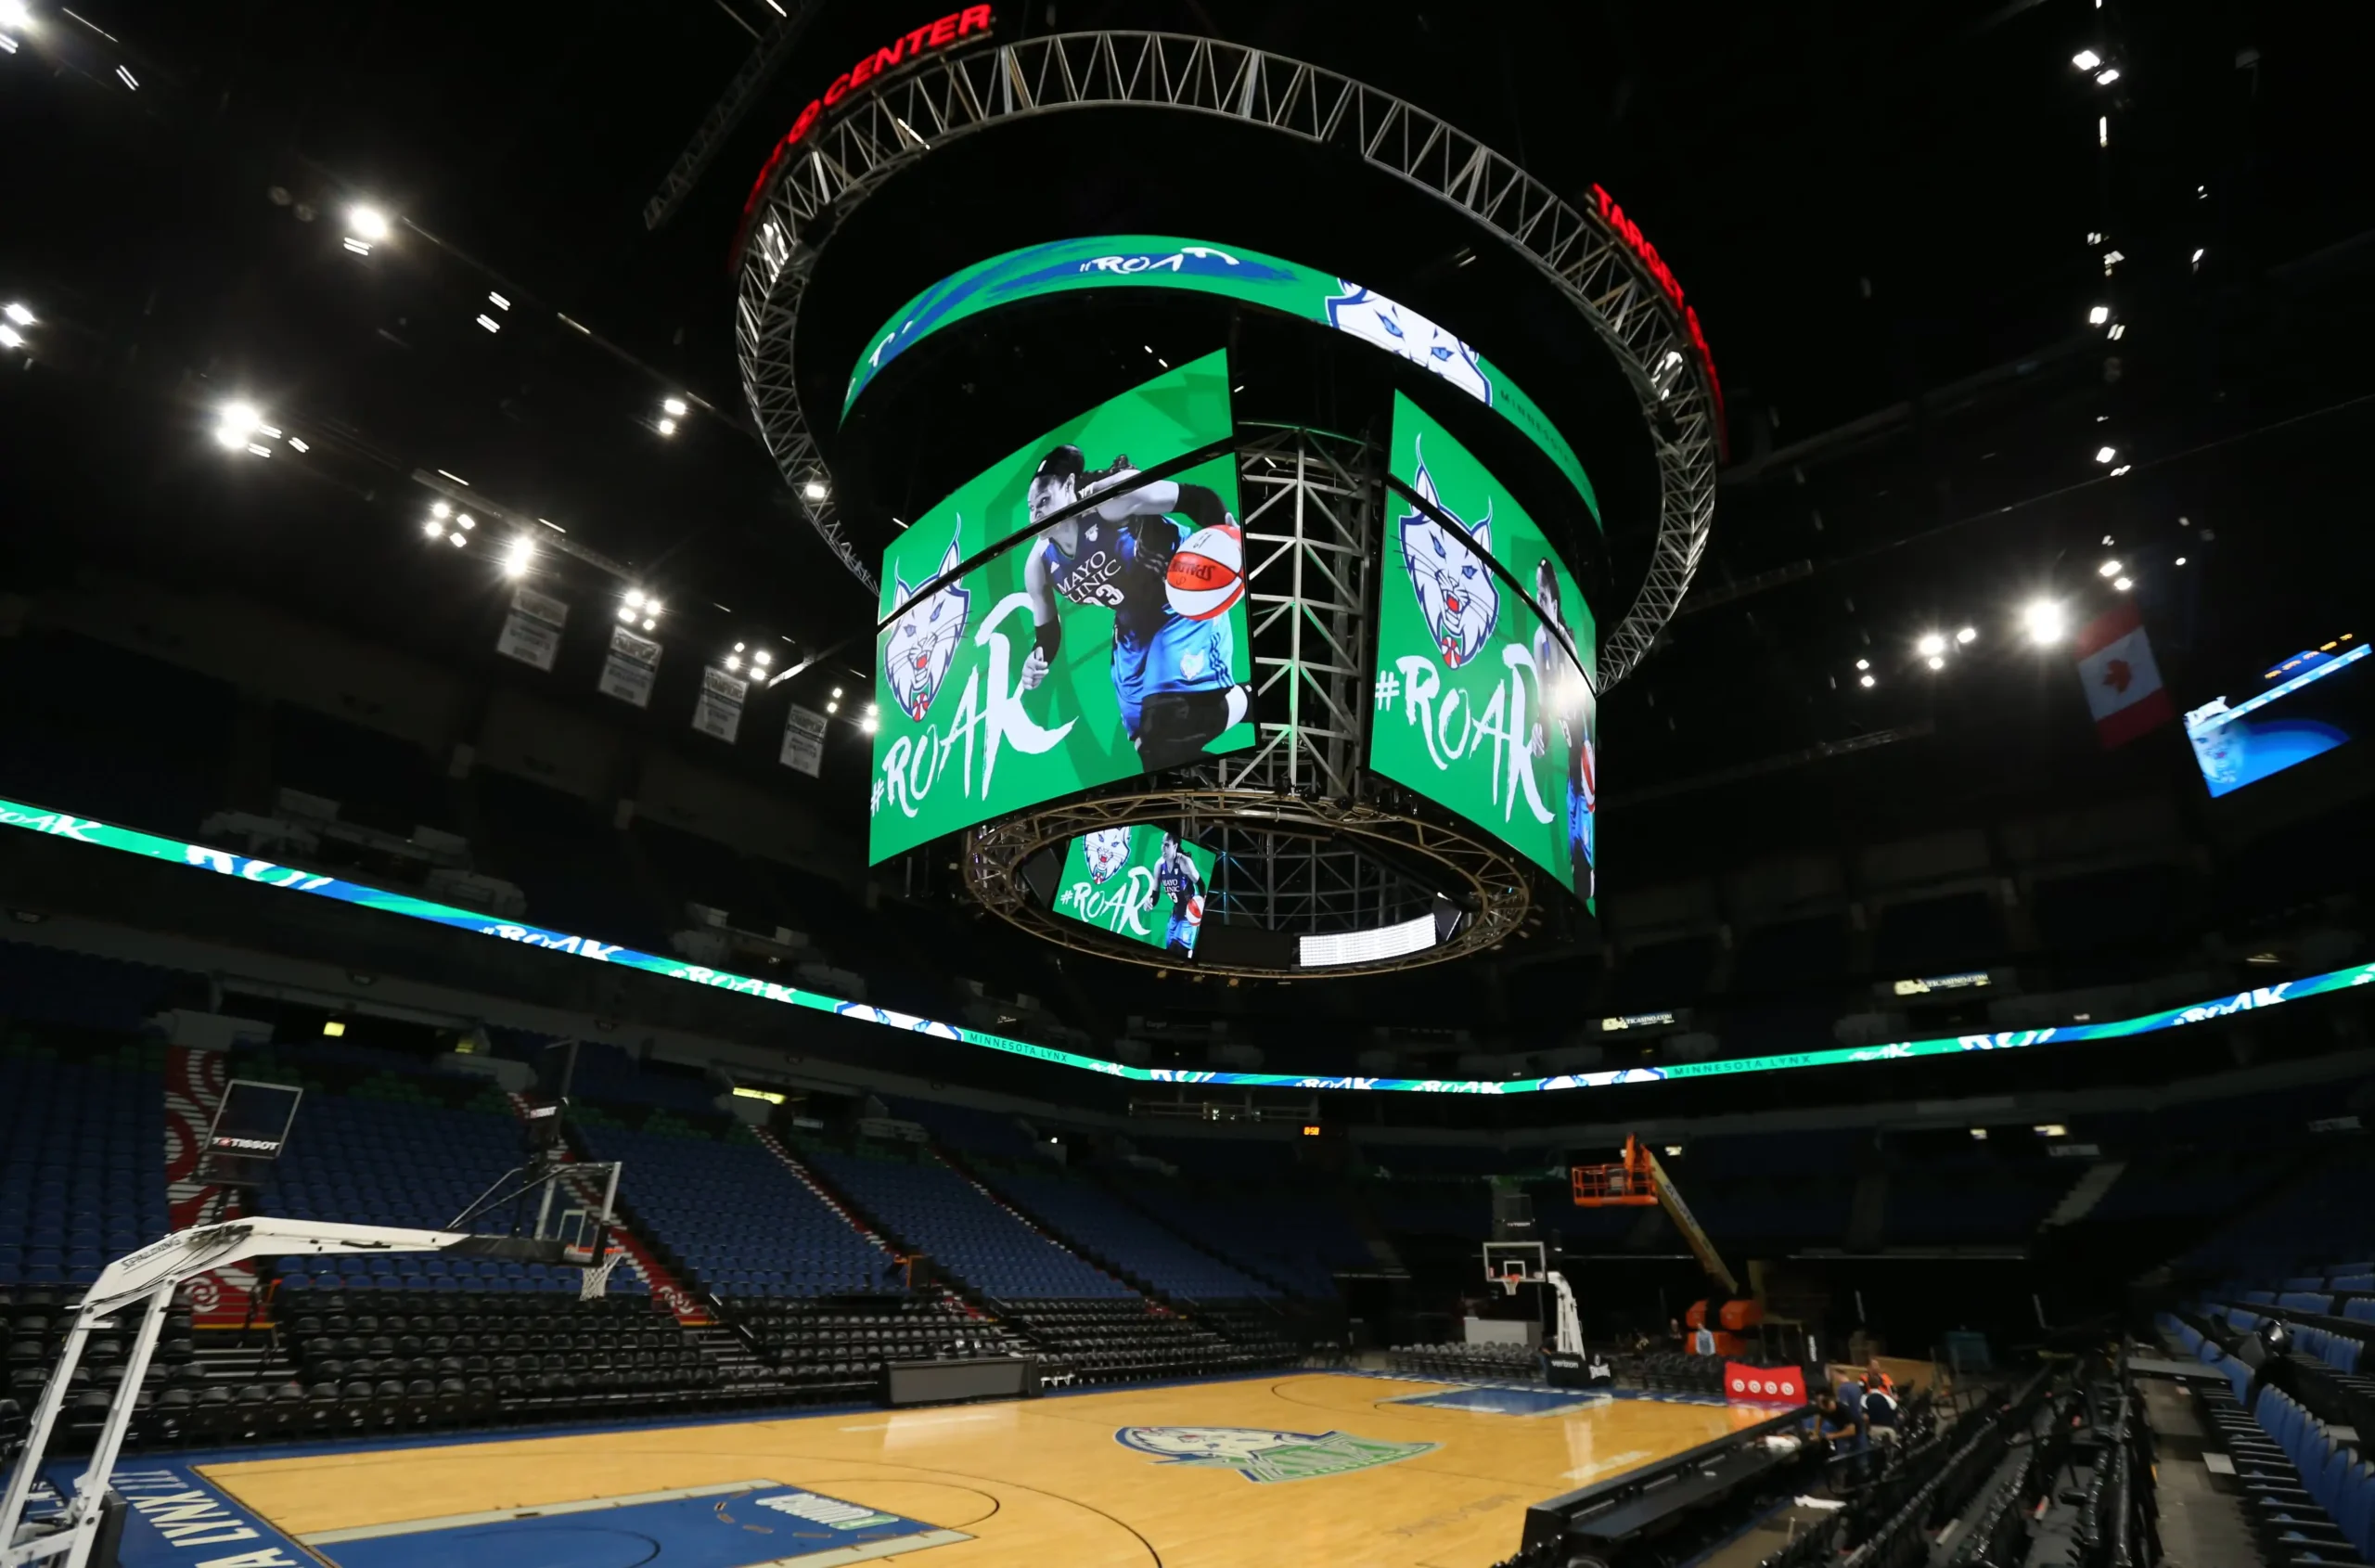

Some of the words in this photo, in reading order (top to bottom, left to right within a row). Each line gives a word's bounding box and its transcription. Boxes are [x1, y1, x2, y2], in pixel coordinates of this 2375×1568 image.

[823, 4, 992, 106] CENTER
[1057, 550, 1106, 595] MAYO
[1067, 559, 1122, 604] LINIC
[969, 1033, 1036, 1056] MINNESOTA
[1041, 1049, 1068, 1063] LYNX
[1675, 1059, 1763, 1076] MINNESOTA
[1770, 1054, 1811, 1069] LYNX
[127, 1489, 261, 1548] LYNX
